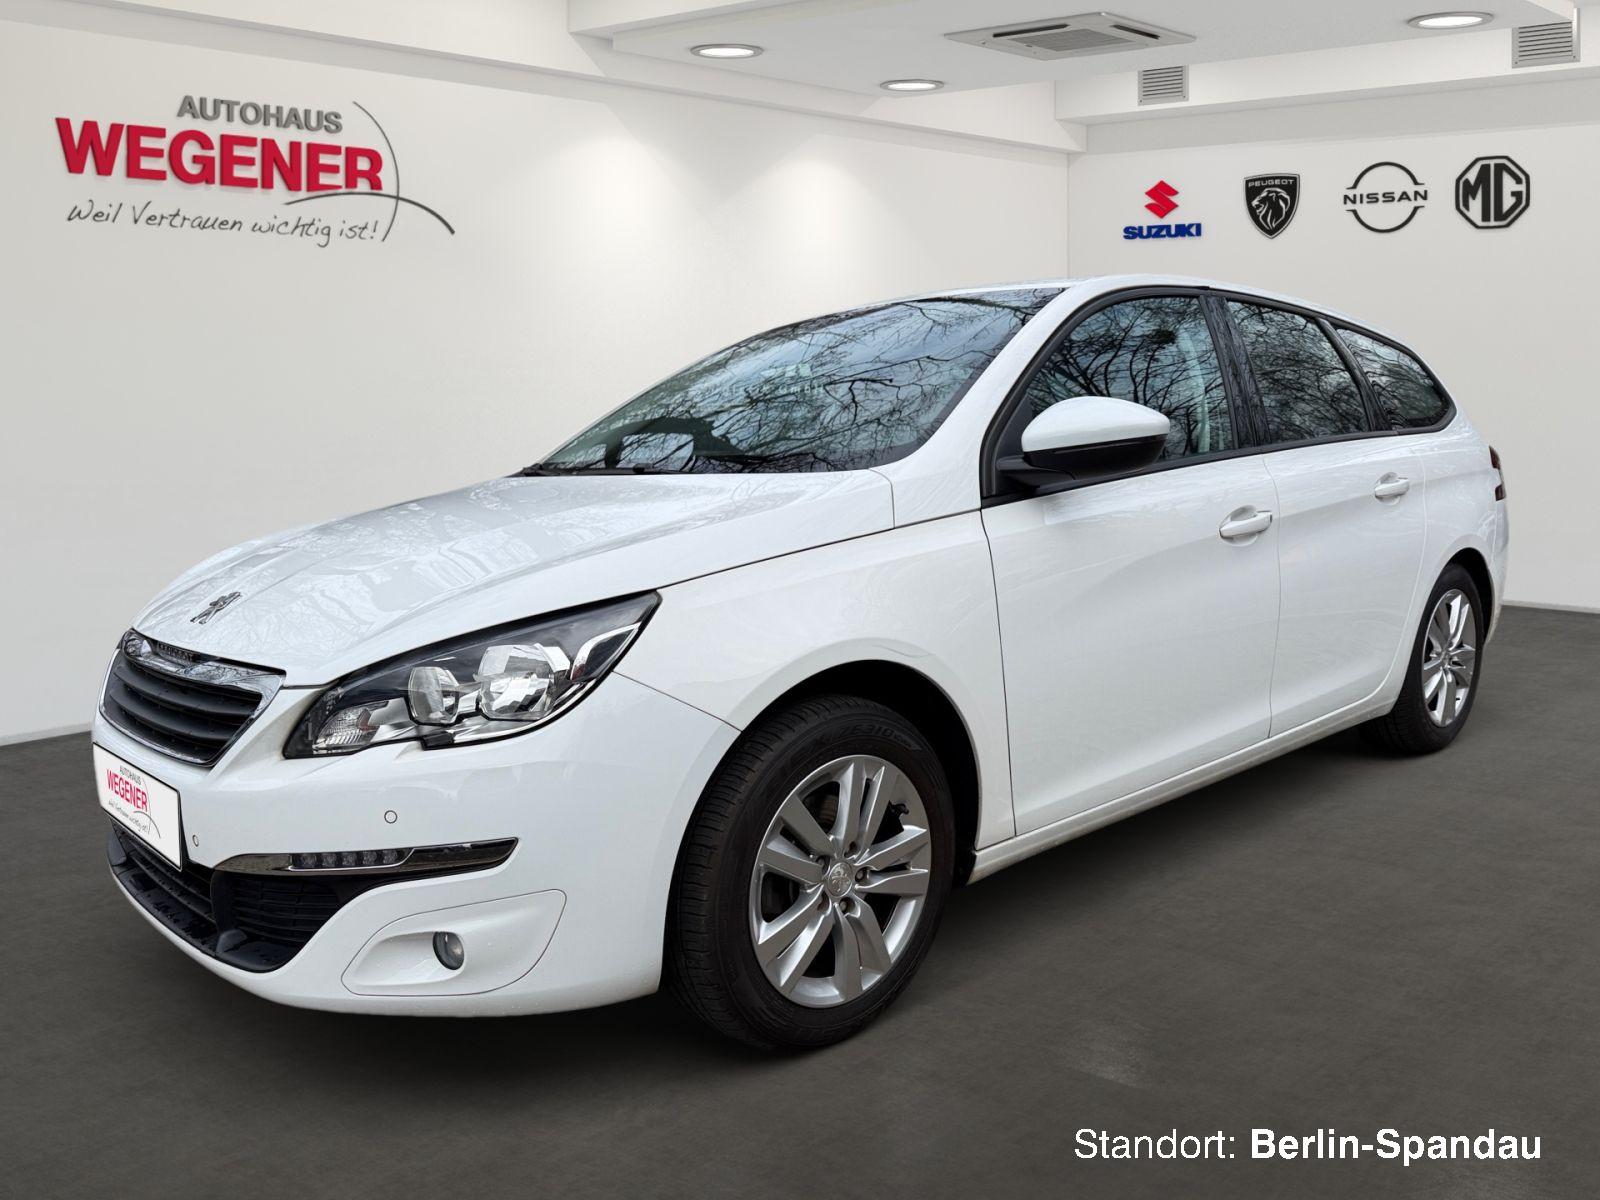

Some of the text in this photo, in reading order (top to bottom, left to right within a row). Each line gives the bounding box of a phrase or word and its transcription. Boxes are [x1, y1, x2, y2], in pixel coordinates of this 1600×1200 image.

[177, 95, 342, 134] AUTOHAUS
[55, 117, 384, 193] WEGENER
[1248, 179, 1295, 187] PEUGEOT
[1343, 189, 1428, 206] NISSAN
[1461, 162, 1524, 223] MG
[67, 200, 378, 248] Weil Vertrauen wichtig ist!
[1123, 223, 1202, 241] SUZUKI
[106, 768, 148, 813] WEGENER
